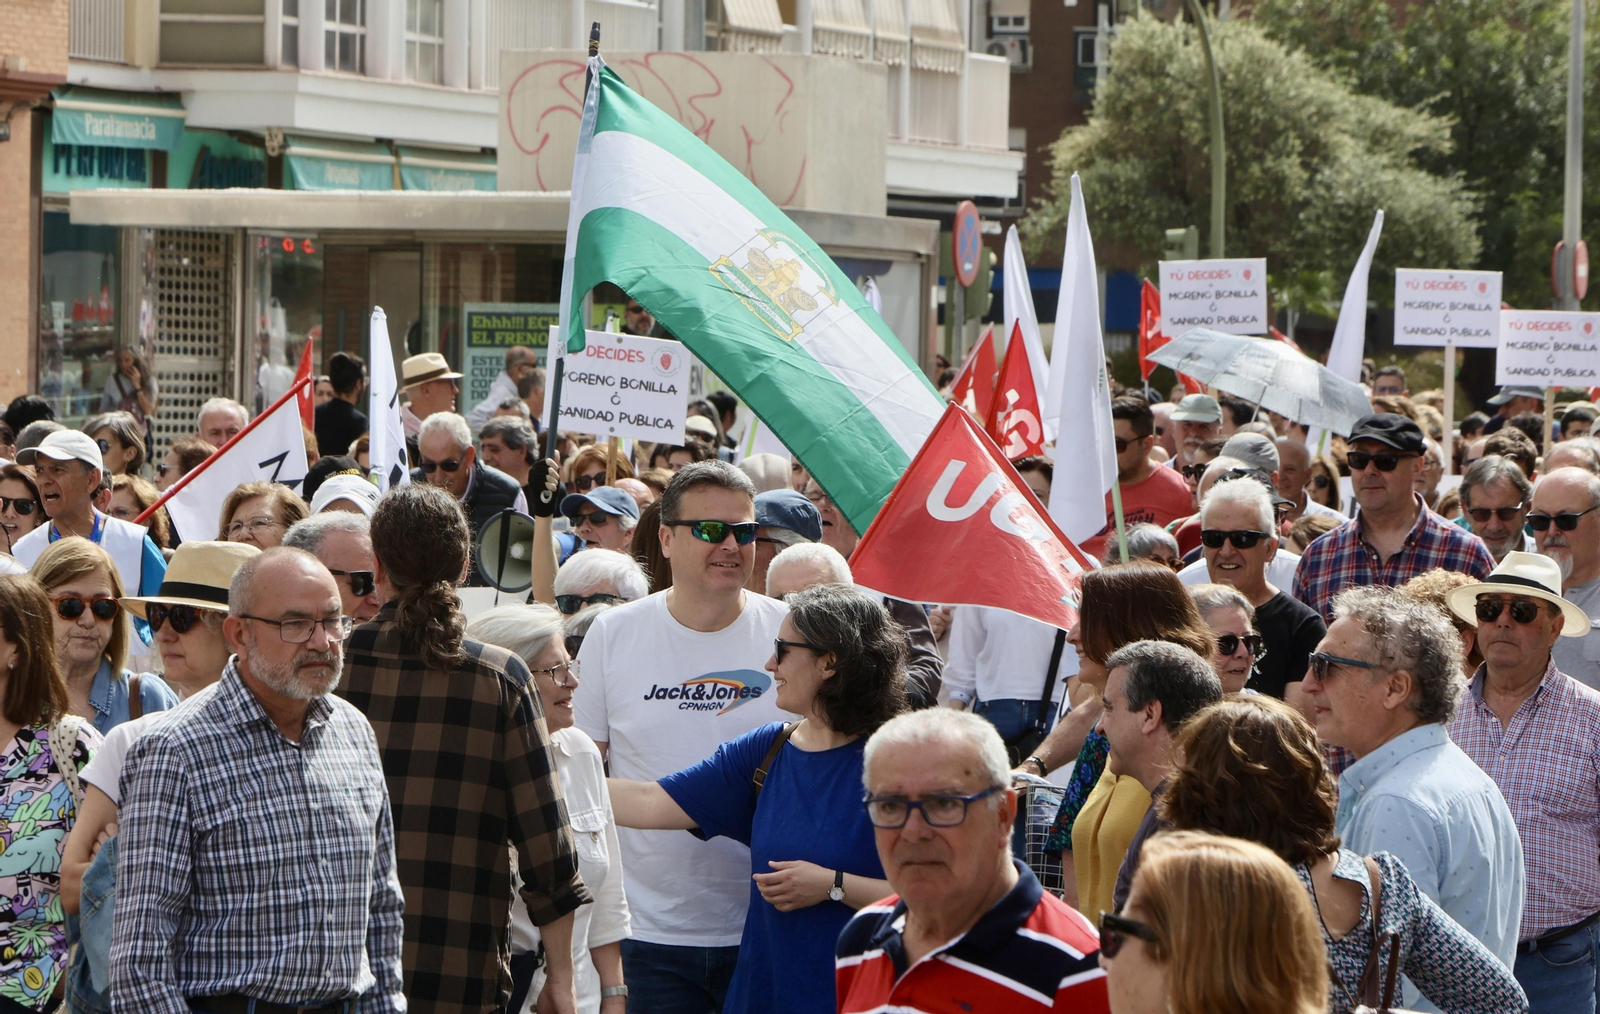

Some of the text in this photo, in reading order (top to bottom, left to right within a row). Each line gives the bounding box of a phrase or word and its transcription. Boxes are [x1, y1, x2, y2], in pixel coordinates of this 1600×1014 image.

[85, 113, 156, 140] Parafarmacia
[1187, 269, 1232, 280] DECIDES
[1423, 281, 1468, 291] DECIDES
[1168, 290, 1258, 300] MORENO BONILLA
[1404, 302, 1492, 311] MORENO BONILLA
[471, 315, 560, 330] Ehhh!!! ECH
[1170, 316, 1258, 325] SANIDAD PUBLICA
[1527, 320, 1572, 331] DECIDES
[1404, 327, 1491, 337] SANIDAD PUBLICA
[471, 330, 548, 346] EL FRENO
[1507, 342, 1597, 351] MORENO BONILLA
[586, 345, 645, 363] DECIDES
[471, 356, 503, 367] ESTE
[1506, 368, 1596, 377] SANIDAD PUBLICA
[563, 371, 677, 395] ORENO BONILLA
[558, 405, 674, 429] SANIDAD PUBLICA
[643, 683, 762, 701] Jack&Jones
[678, 701, 725, 711] CPNHGN
